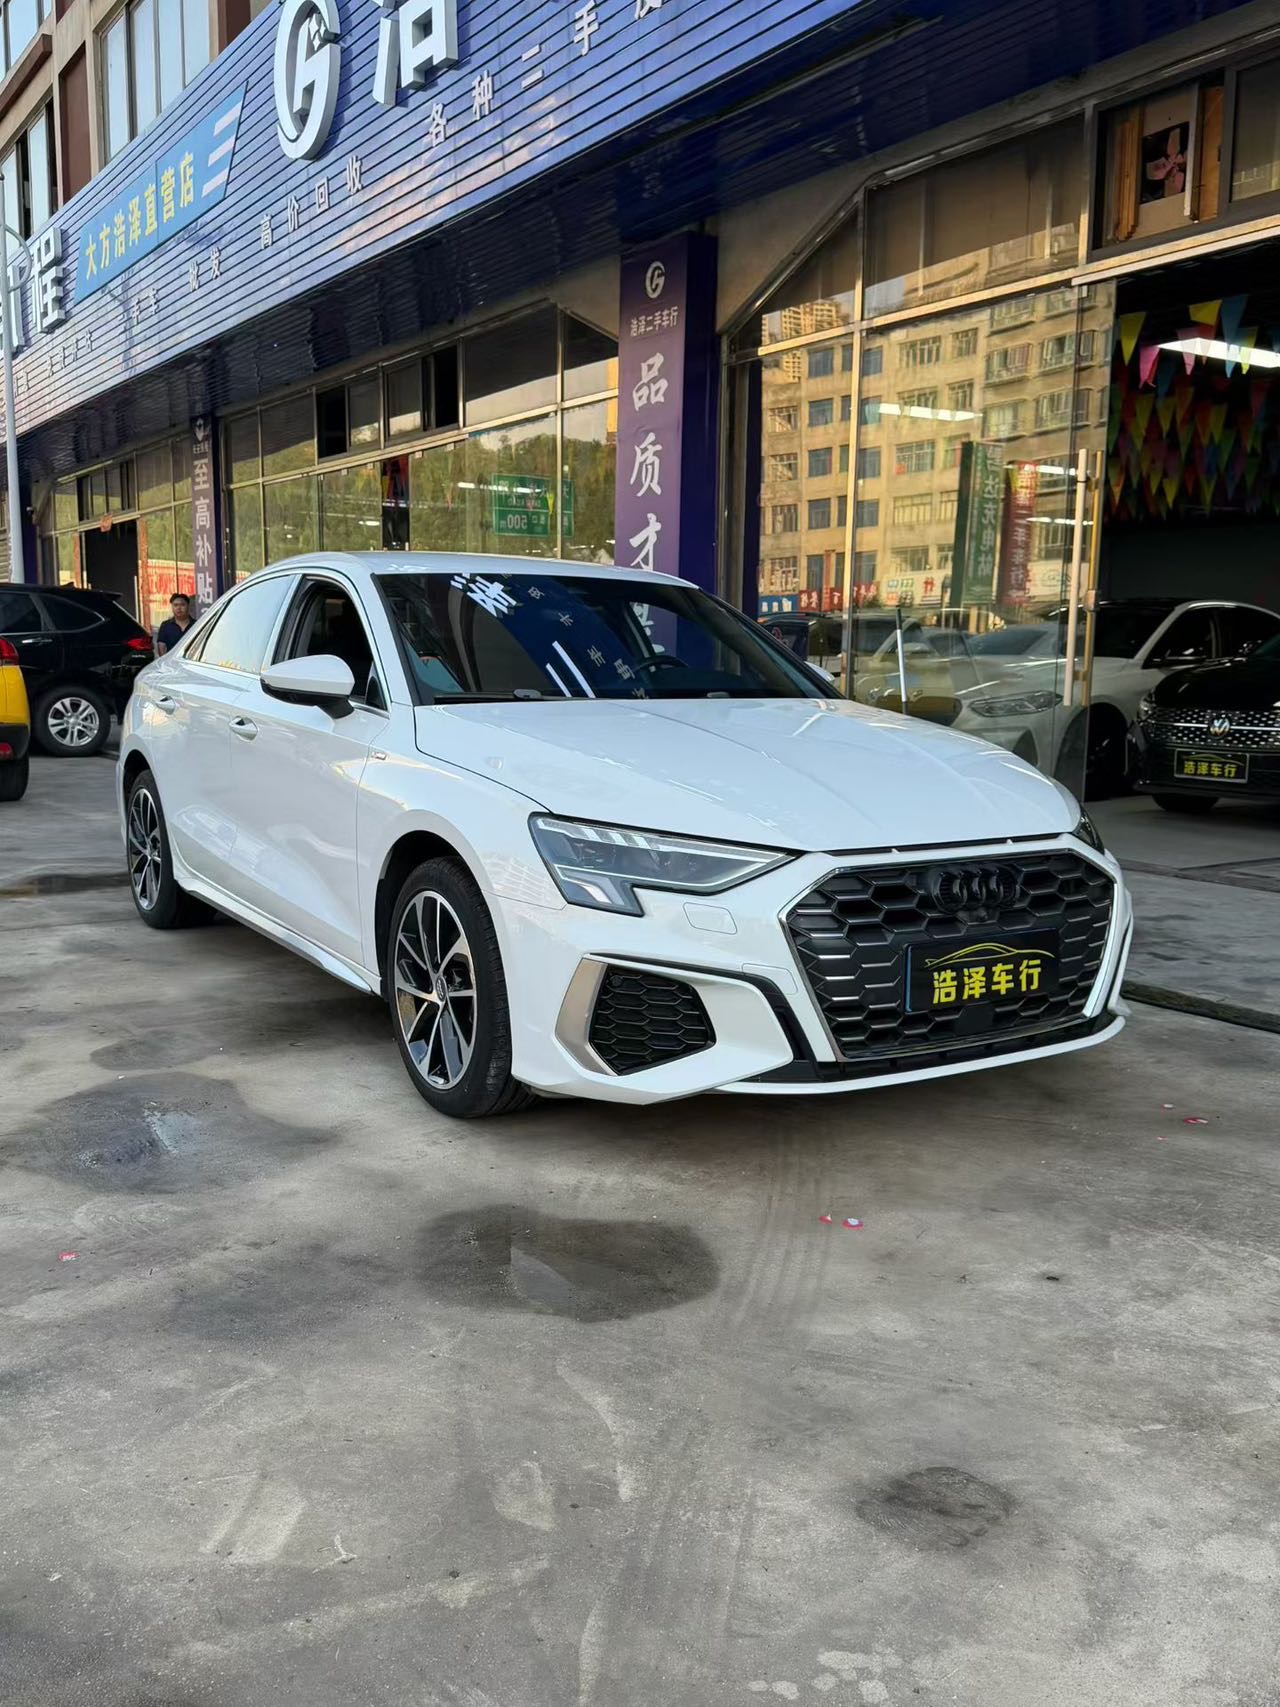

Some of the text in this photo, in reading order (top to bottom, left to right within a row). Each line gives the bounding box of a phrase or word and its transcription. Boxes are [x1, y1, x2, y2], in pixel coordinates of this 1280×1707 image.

[85, 151, 195, 281] 大方浩泽直营店
[259, 154, 364, 251] 高价回收
[630, 305, 679, 337] 浩泽二手车行
[1183, 759, 1238, 779] 浩泽车行
[932, 958, 1042, 1004] 浩泽车行
